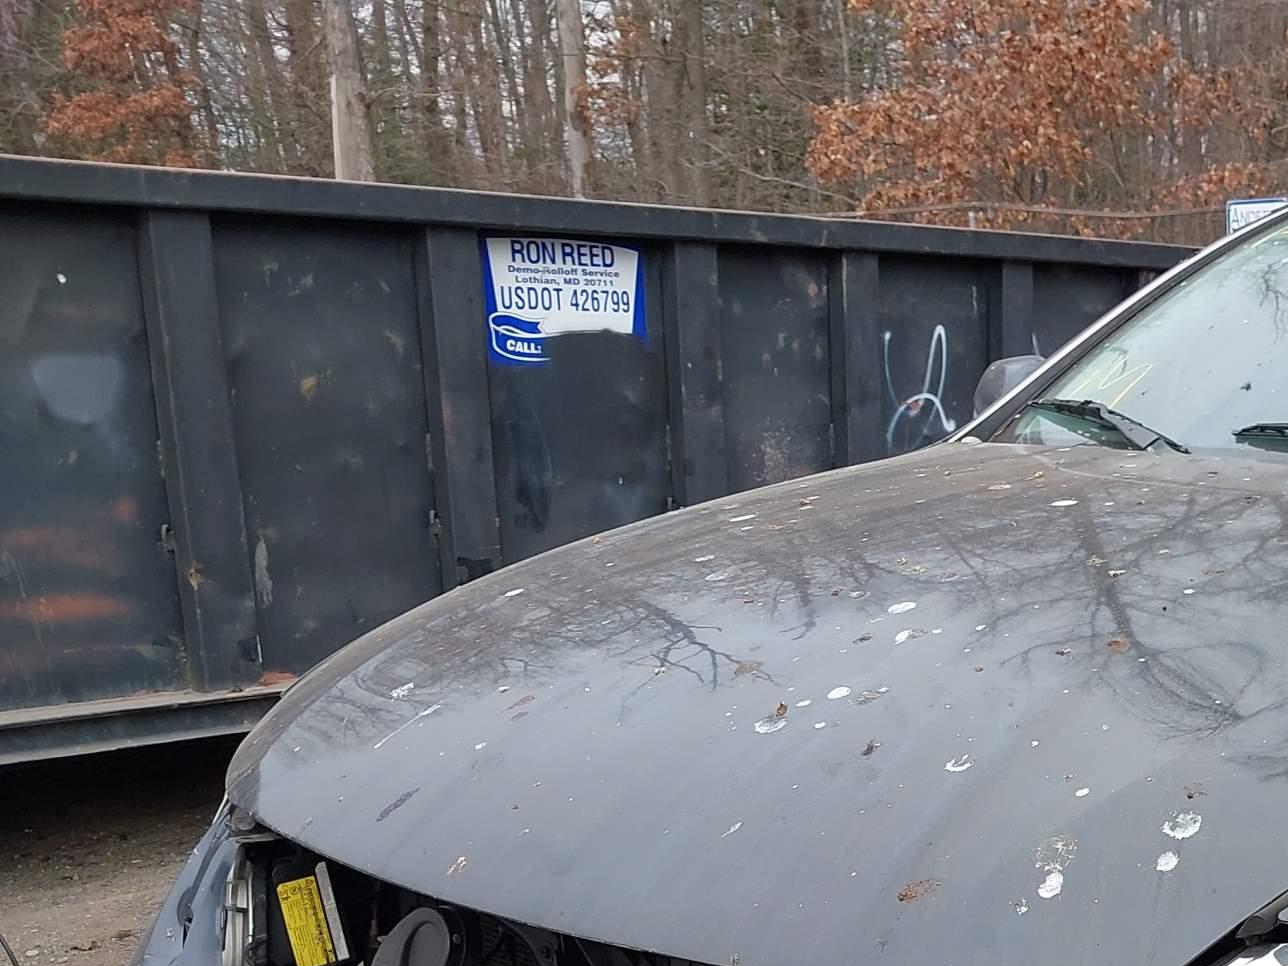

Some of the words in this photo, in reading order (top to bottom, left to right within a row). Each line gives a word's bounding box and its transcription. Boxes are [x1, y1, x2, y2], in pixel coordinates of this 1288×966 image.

[510, 239, 556, 265] RON
[560, 242, 615, 268] REED
[507, 264, 578, 276] Demo-Rolloff
[581, 268, 620, 278] Service
[515, 275, 560, 286] Lothian,
[563, 277, 580, 286] MD
[584, 278, 614, 287] 20711
[500, 286, 562, 311] USDOT
[570, 289, 630, 312] 426799
[506, 338, 543, 355] CALL:
